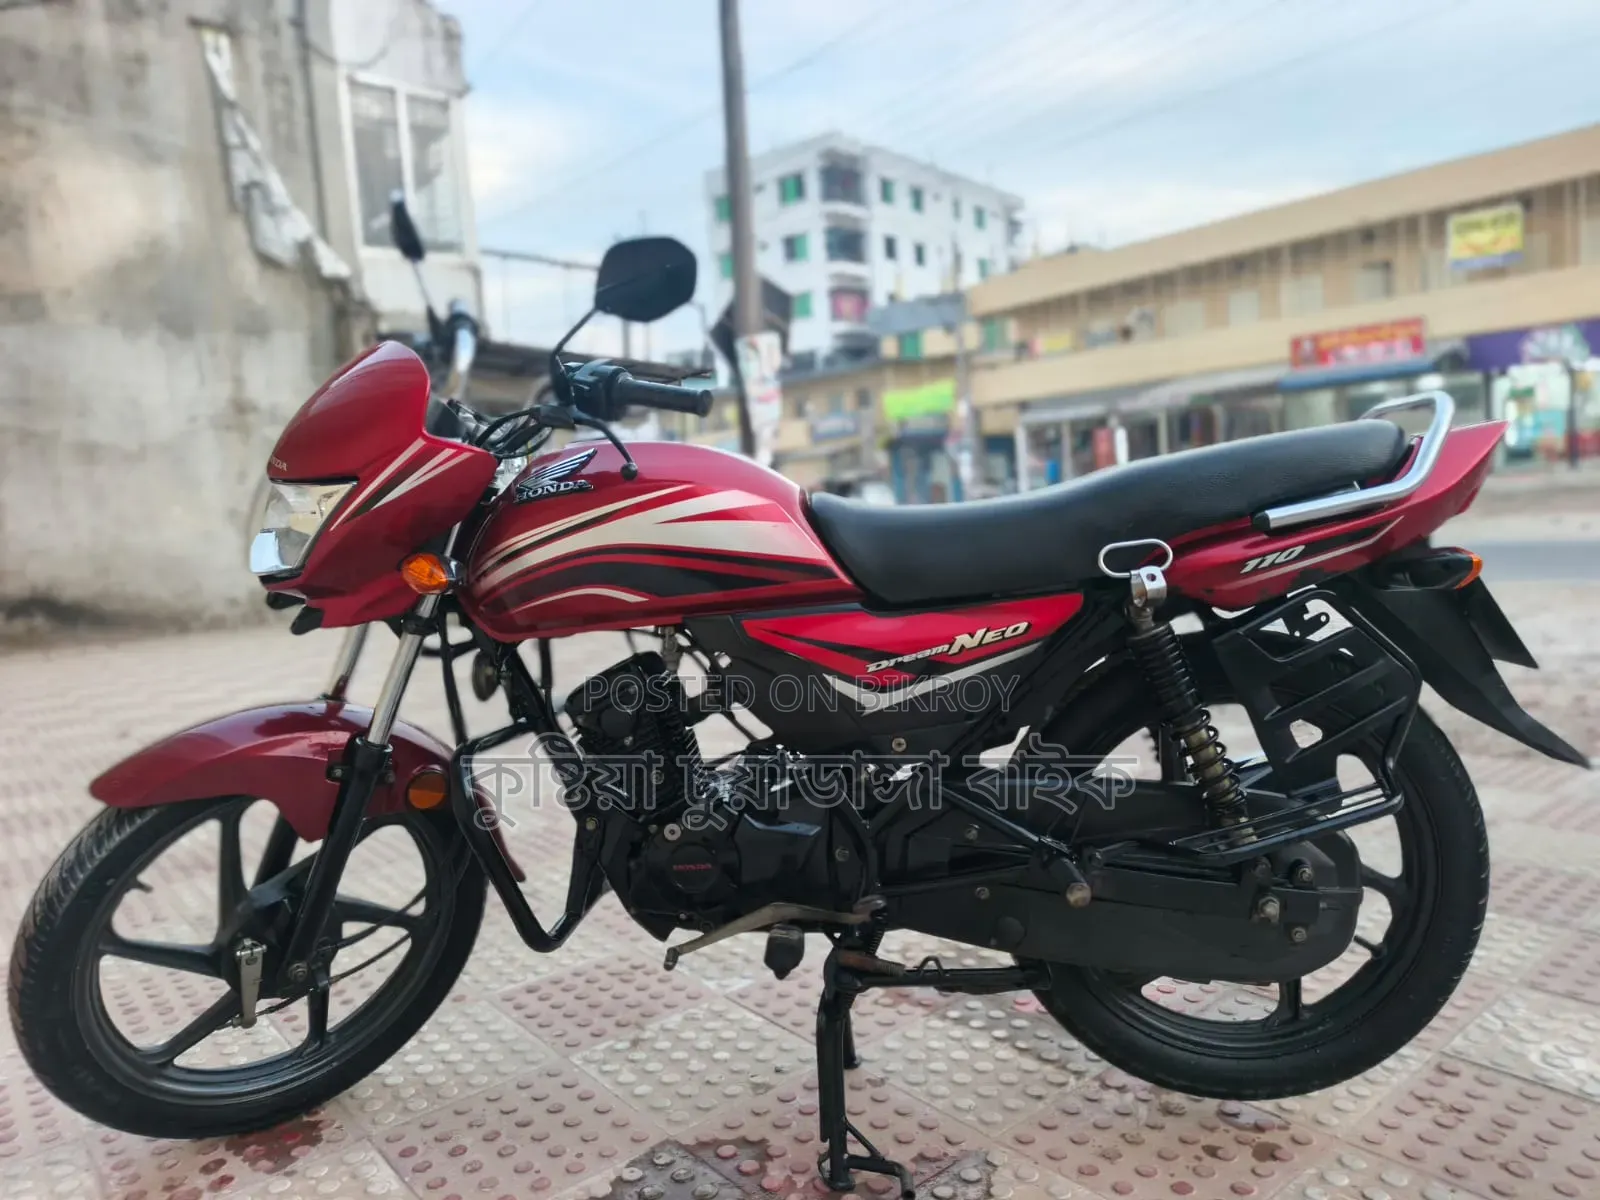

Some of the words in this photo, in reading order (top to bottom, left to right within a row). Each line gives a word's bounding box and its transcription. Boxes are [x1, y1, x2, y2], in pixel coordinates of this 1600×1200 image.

[514, 480, 594, 503] HONDA
[1240, 544, 1306, 574] 110
[866, 644, 950, 673] Dream
